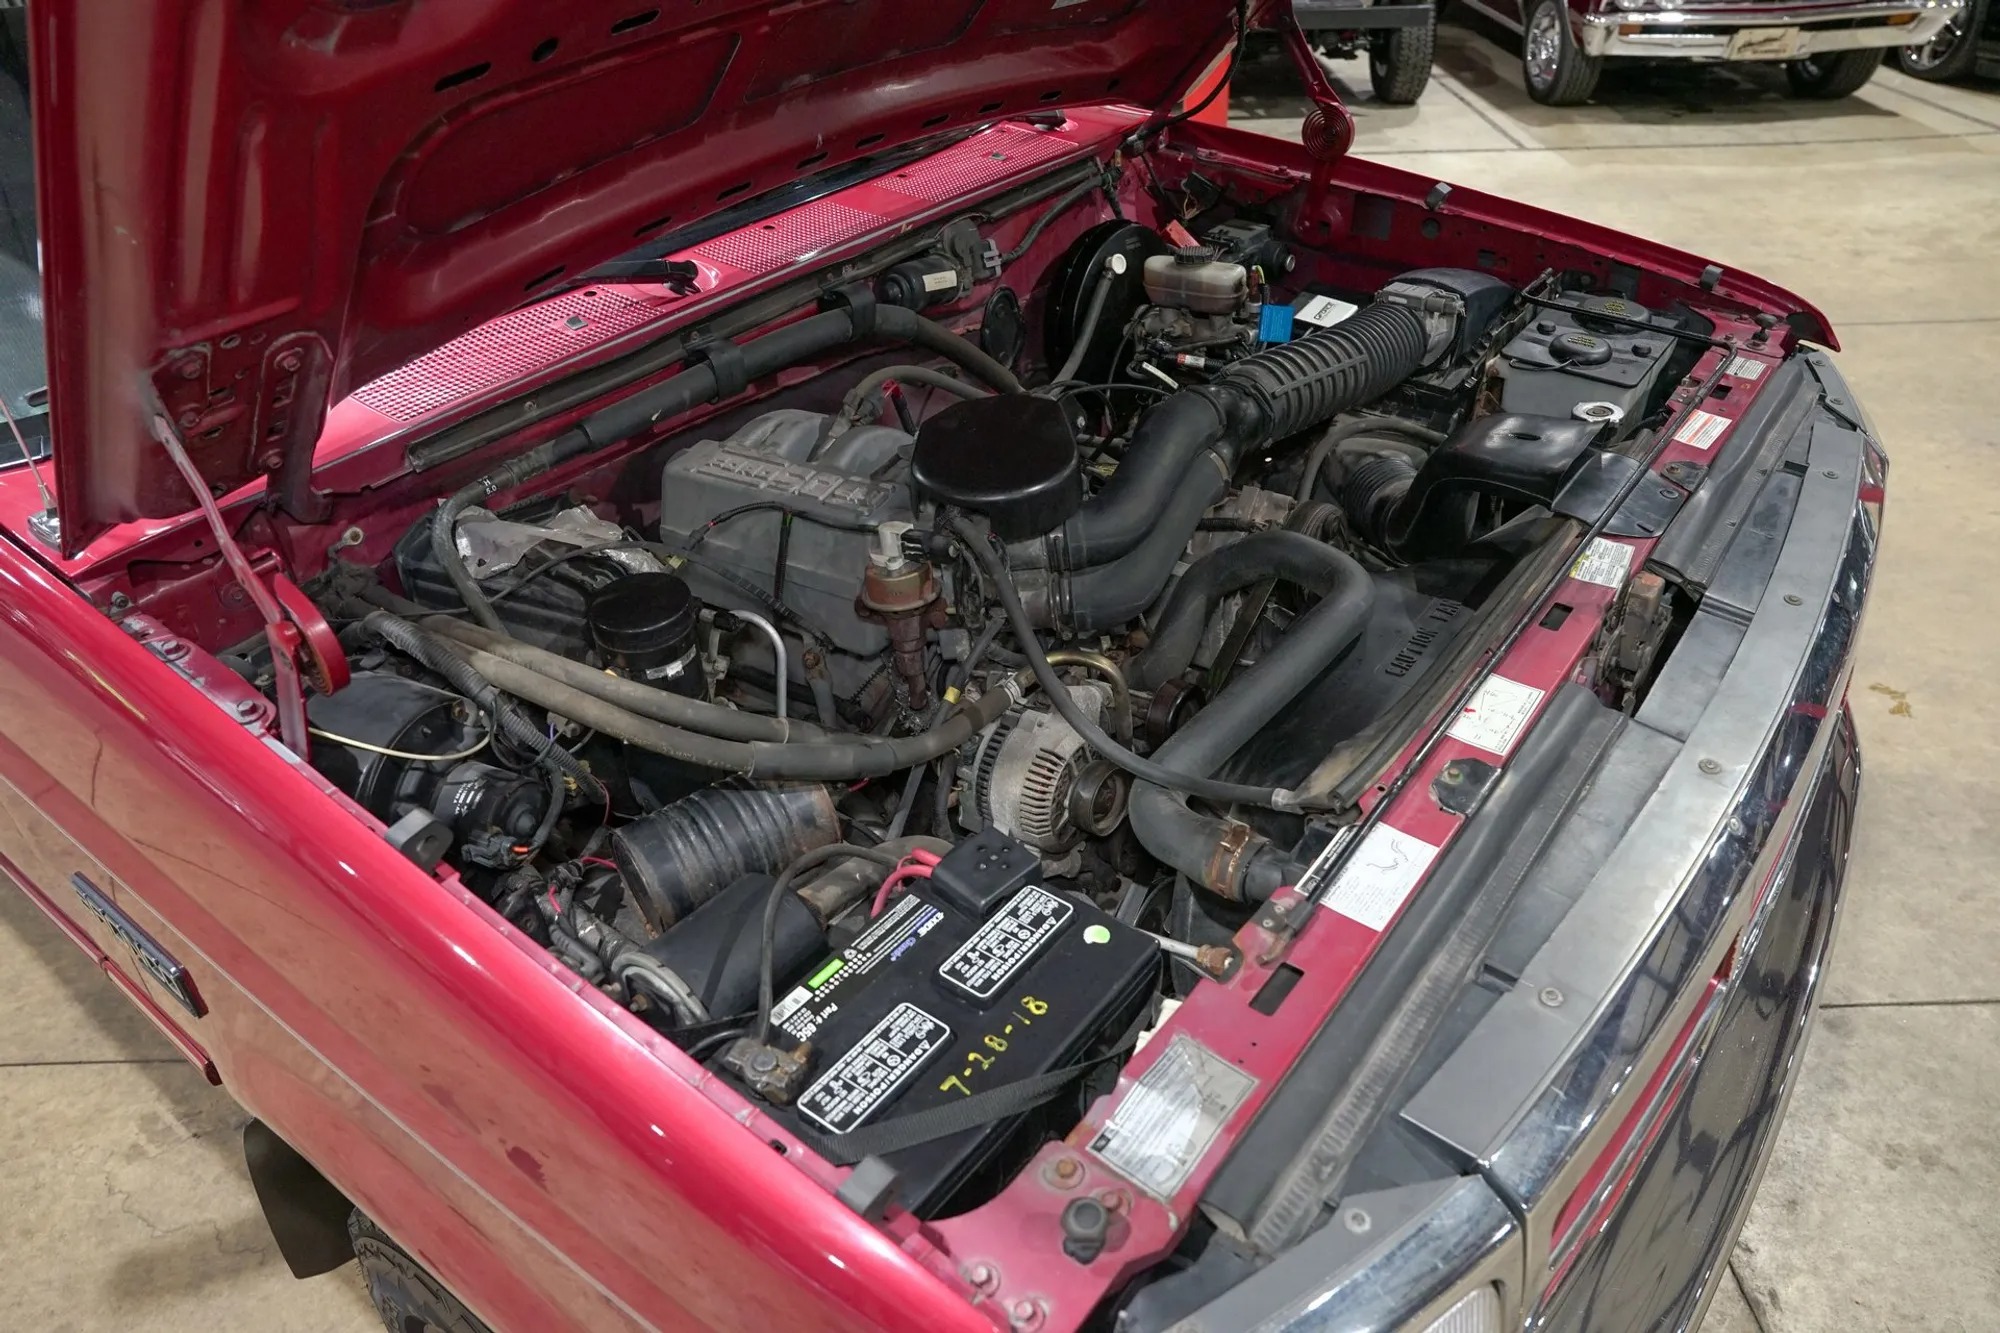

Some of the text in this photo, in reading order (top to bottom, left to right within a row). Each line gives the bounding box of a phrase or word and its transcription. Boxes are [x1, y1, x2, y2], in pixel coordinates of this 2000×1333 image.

[1385, 627, 1438, 677] CAUTION
[917, 911, 944, 937] EXIDE
[820, 1002, 838, 1019] Part
[796, 1022, 817, 1042] 65C
[940, 996, 1048, 1096] 7-28-18
